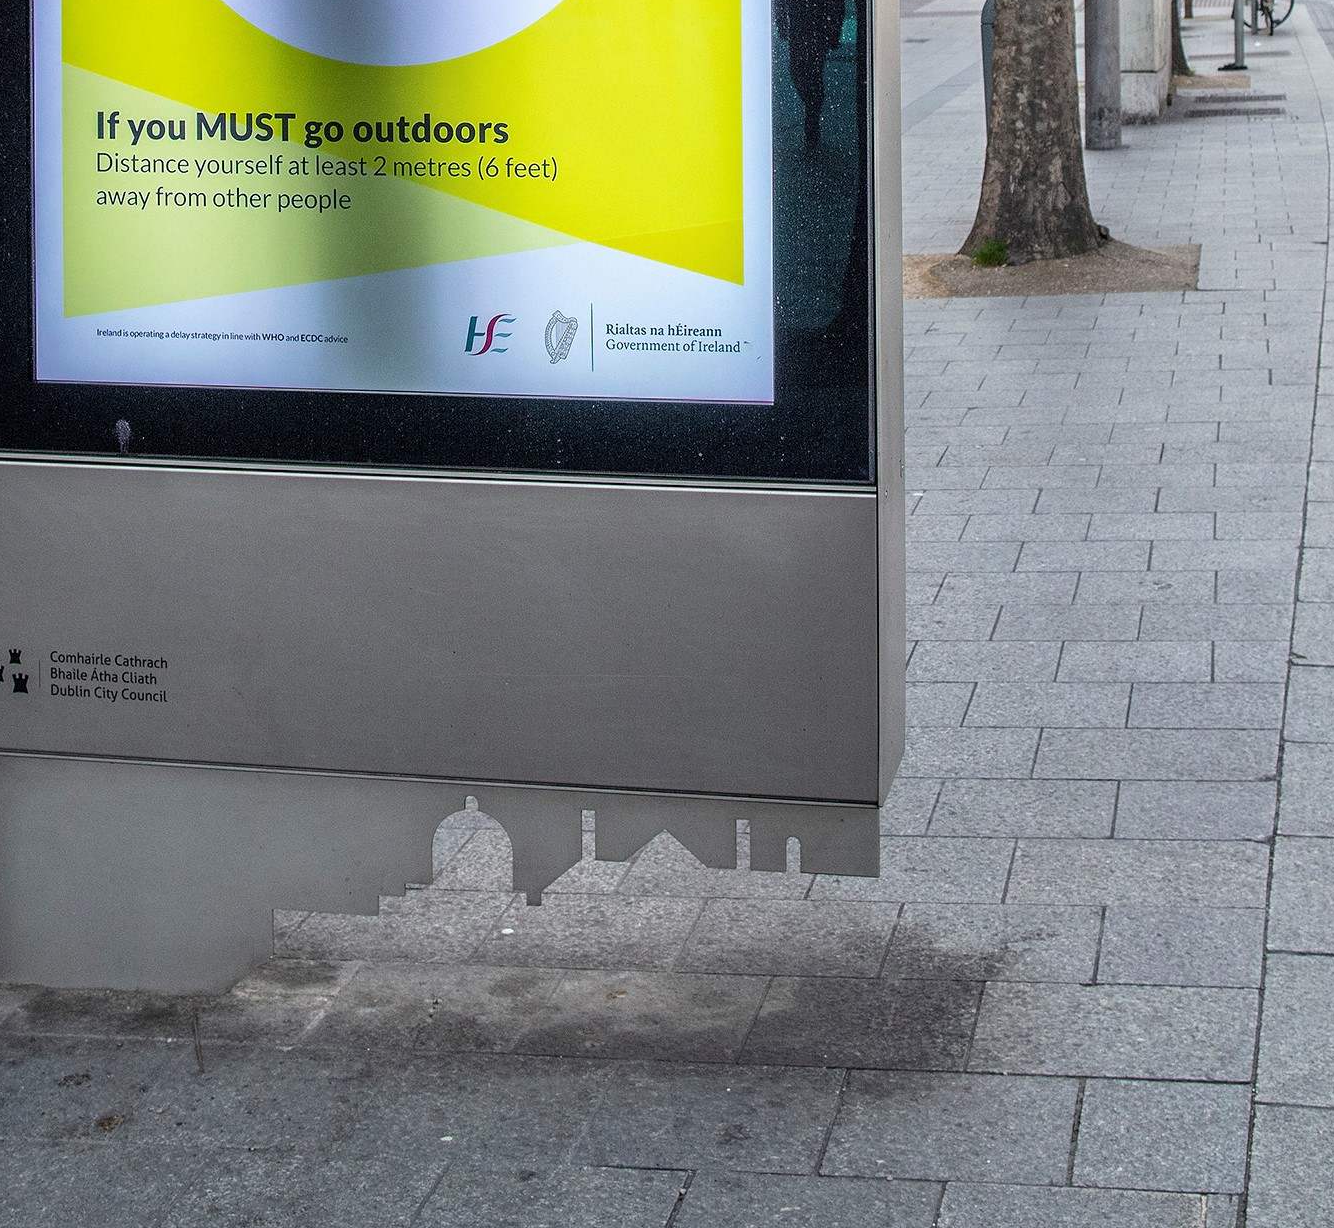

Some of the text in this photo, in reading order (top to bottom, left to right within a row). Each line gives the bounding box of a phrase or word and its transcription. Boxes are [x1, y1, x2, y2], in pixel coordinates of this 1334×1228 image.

[96, 111, 509, 148] If you MUST go outdoors
[96, 152, 558, 182] Distance yourself at least 2 metres (6 feet)
[96, 187, 352, 214] away from other people
[96, 328, 123, 337] Ireland
[123, 329, 129, 337] is
[129, 329, 165, 340] operating
[170, 330, 191, 341] delay
[191, 331, 221, 341] strategy
[222, 331, 230, 340] in
[230, 331, 244, 340] line
[244, 332, 261, 341] with
[262, 333, 285, 342] WHO
[285, 333, 300, 342] and
[300, 334, 324, 343] ECDC
[324, 335, 349, 344] advice
[605, 320, 722, 337] Rialtas na hÉireann
[605, 340, 741, 353] Government of Ireland
[50, 650, 168, 669] Comhairle Cathrach
[50, 667, 157, 685] Bhaile Átha Cliath
[50, 683, 168, 703] Dublin City Council
